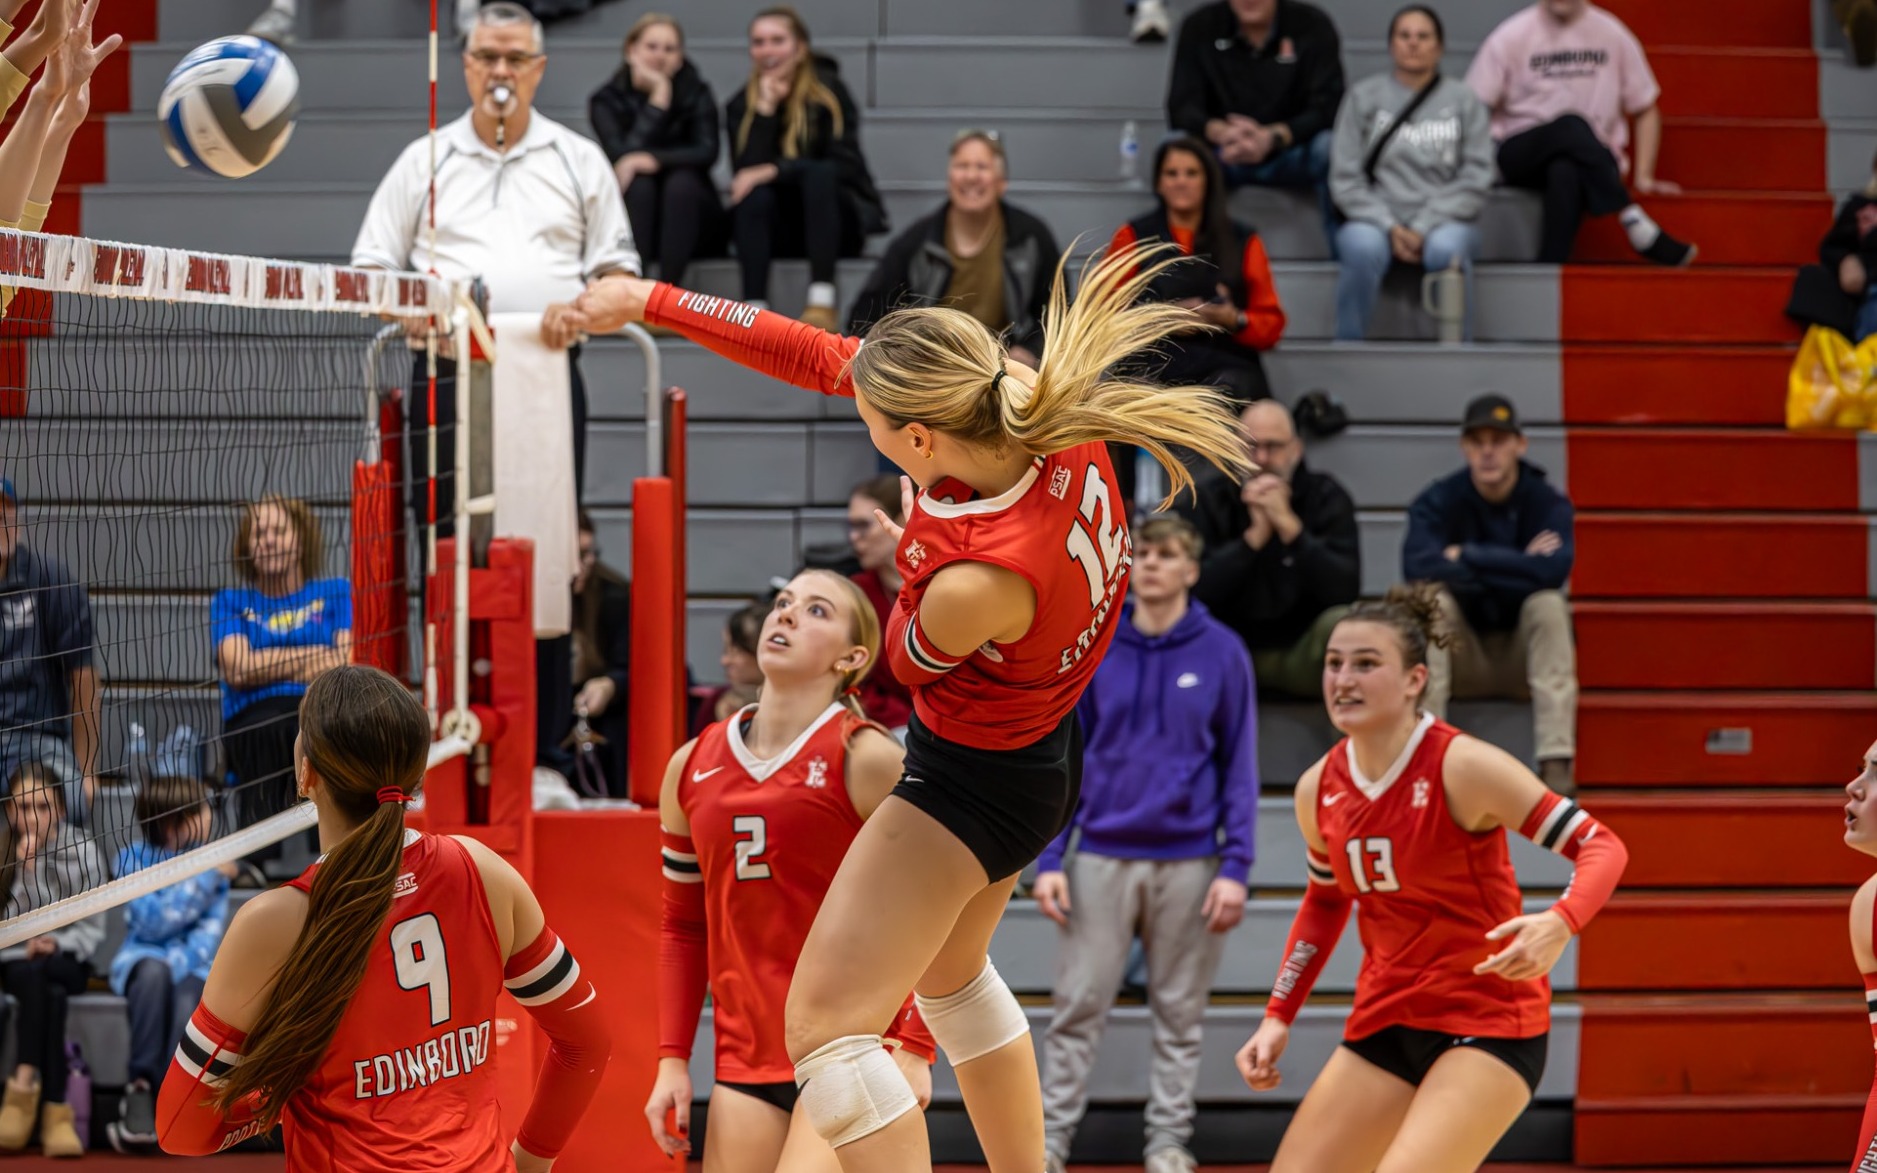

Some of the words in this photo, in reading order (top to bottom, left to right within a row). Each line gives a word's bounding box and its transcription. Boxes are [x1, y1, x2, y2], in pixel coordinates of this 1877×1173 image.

[677, 290, 760, 329] FIGHTING
[1050, 465, 1070, 499] PSAC
[1065, 461, 1125, 611] 12
[732, 814, 772, 882] 2
[1345, 836, 1401, 894] 13
[394, 876, 418, 893] SAC
[389, 911, 452, 1027] 9
[353, 1019, 492, 1100] EDINBORO
